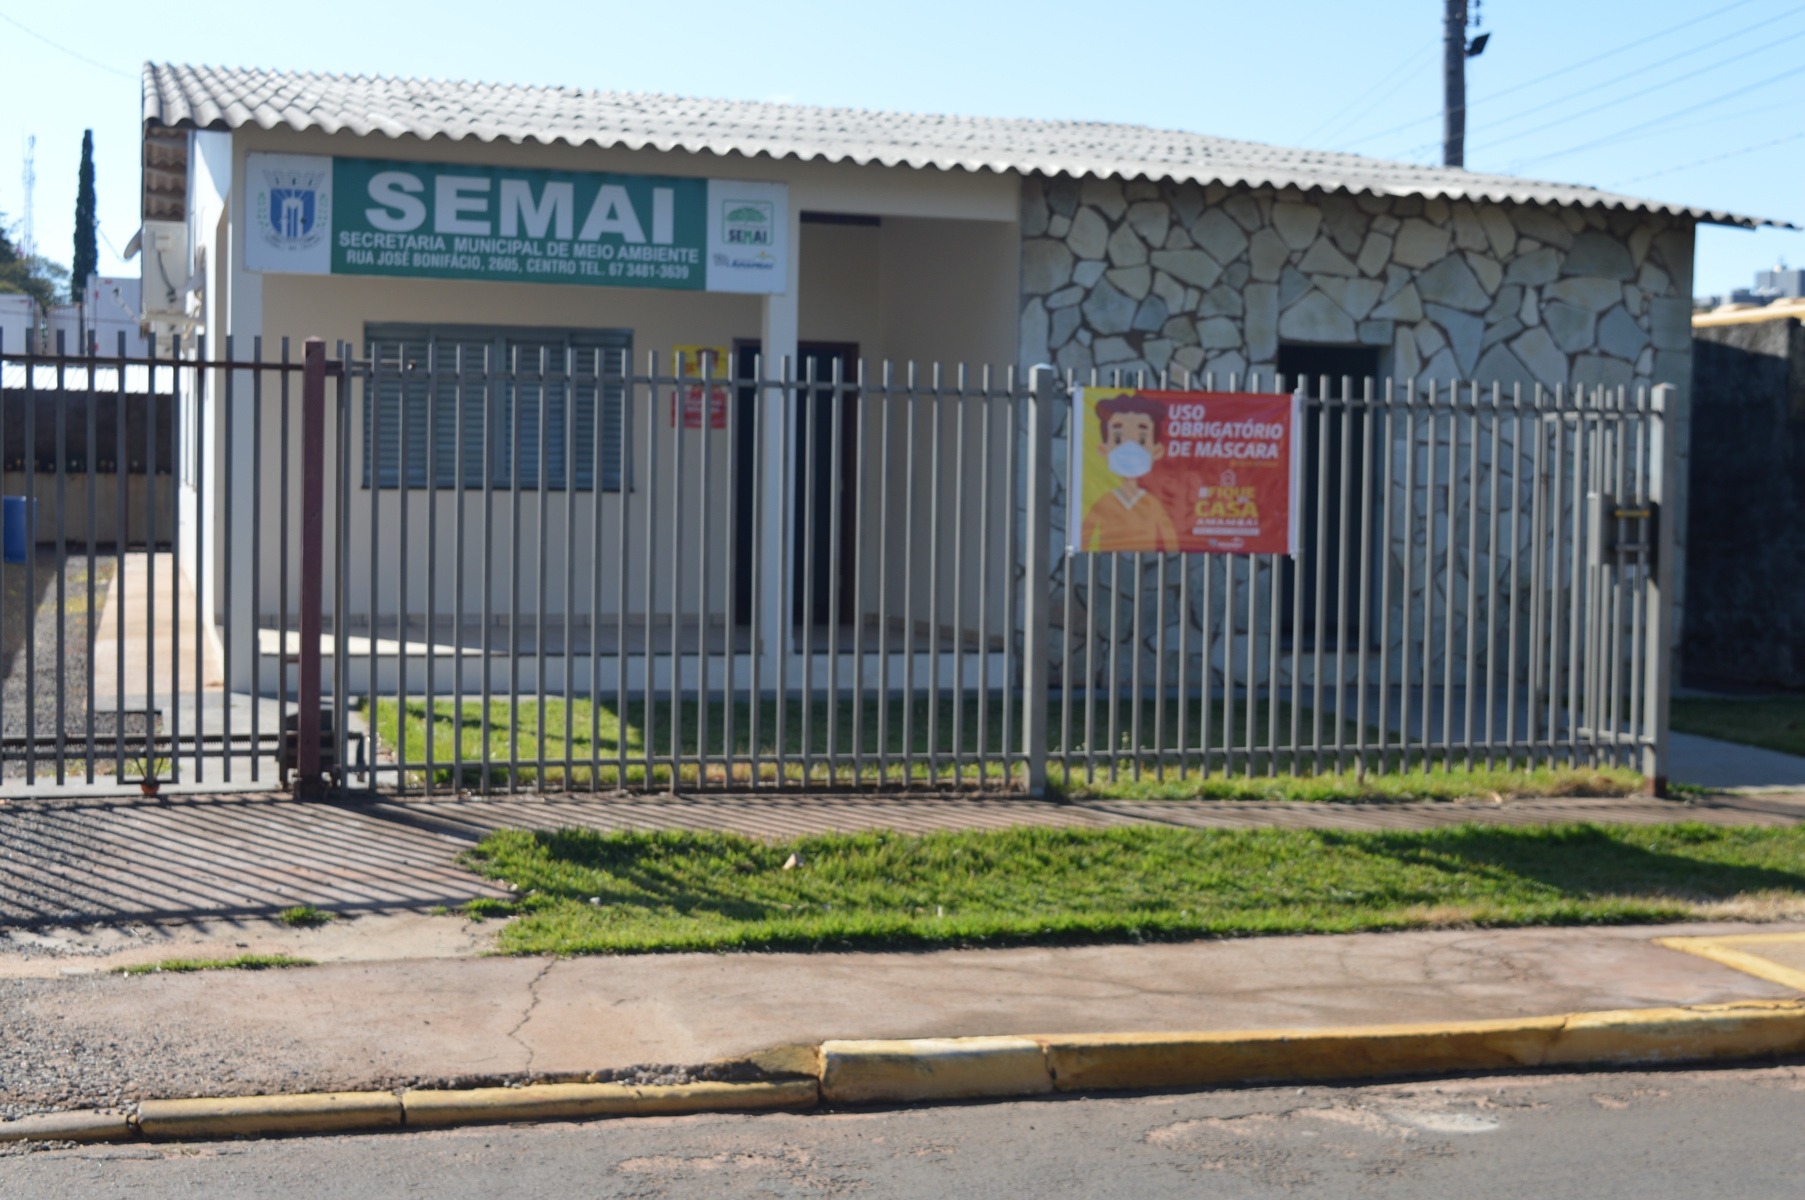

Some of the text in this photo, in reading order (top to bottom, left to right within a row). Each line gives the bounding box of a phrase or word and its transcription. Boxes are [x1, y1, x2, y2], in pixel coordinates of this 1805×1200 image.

[365, 171, 674, 245] SEMAI
[339, 231, 446, 251] SECRETARIA
[454, 237, 542, 256] MUNICIPAL
[547, 242, 570, 257] DE
[573, 243, 614, 260] MEIO
[617, 247, 699, 264] AMBIENTE
[346, 250, 374, 264] RUA
[377, 251, 409, 267] JOSÉ
[412, 252, 485, 272] BONIFÁCIO,
[526, 259, 576, 274] CENTRO
[579, 262, 605, 276] TEL.
[608, 263, 624, 276] 67
[1168, 404, 1205, 421] USO
[1168, 418, 1284, 440] OBRIGATÓRIO
[1168, 438, 1279, 459] DE MÁSCARA
[1195, 501, 1259, 518] CASA
